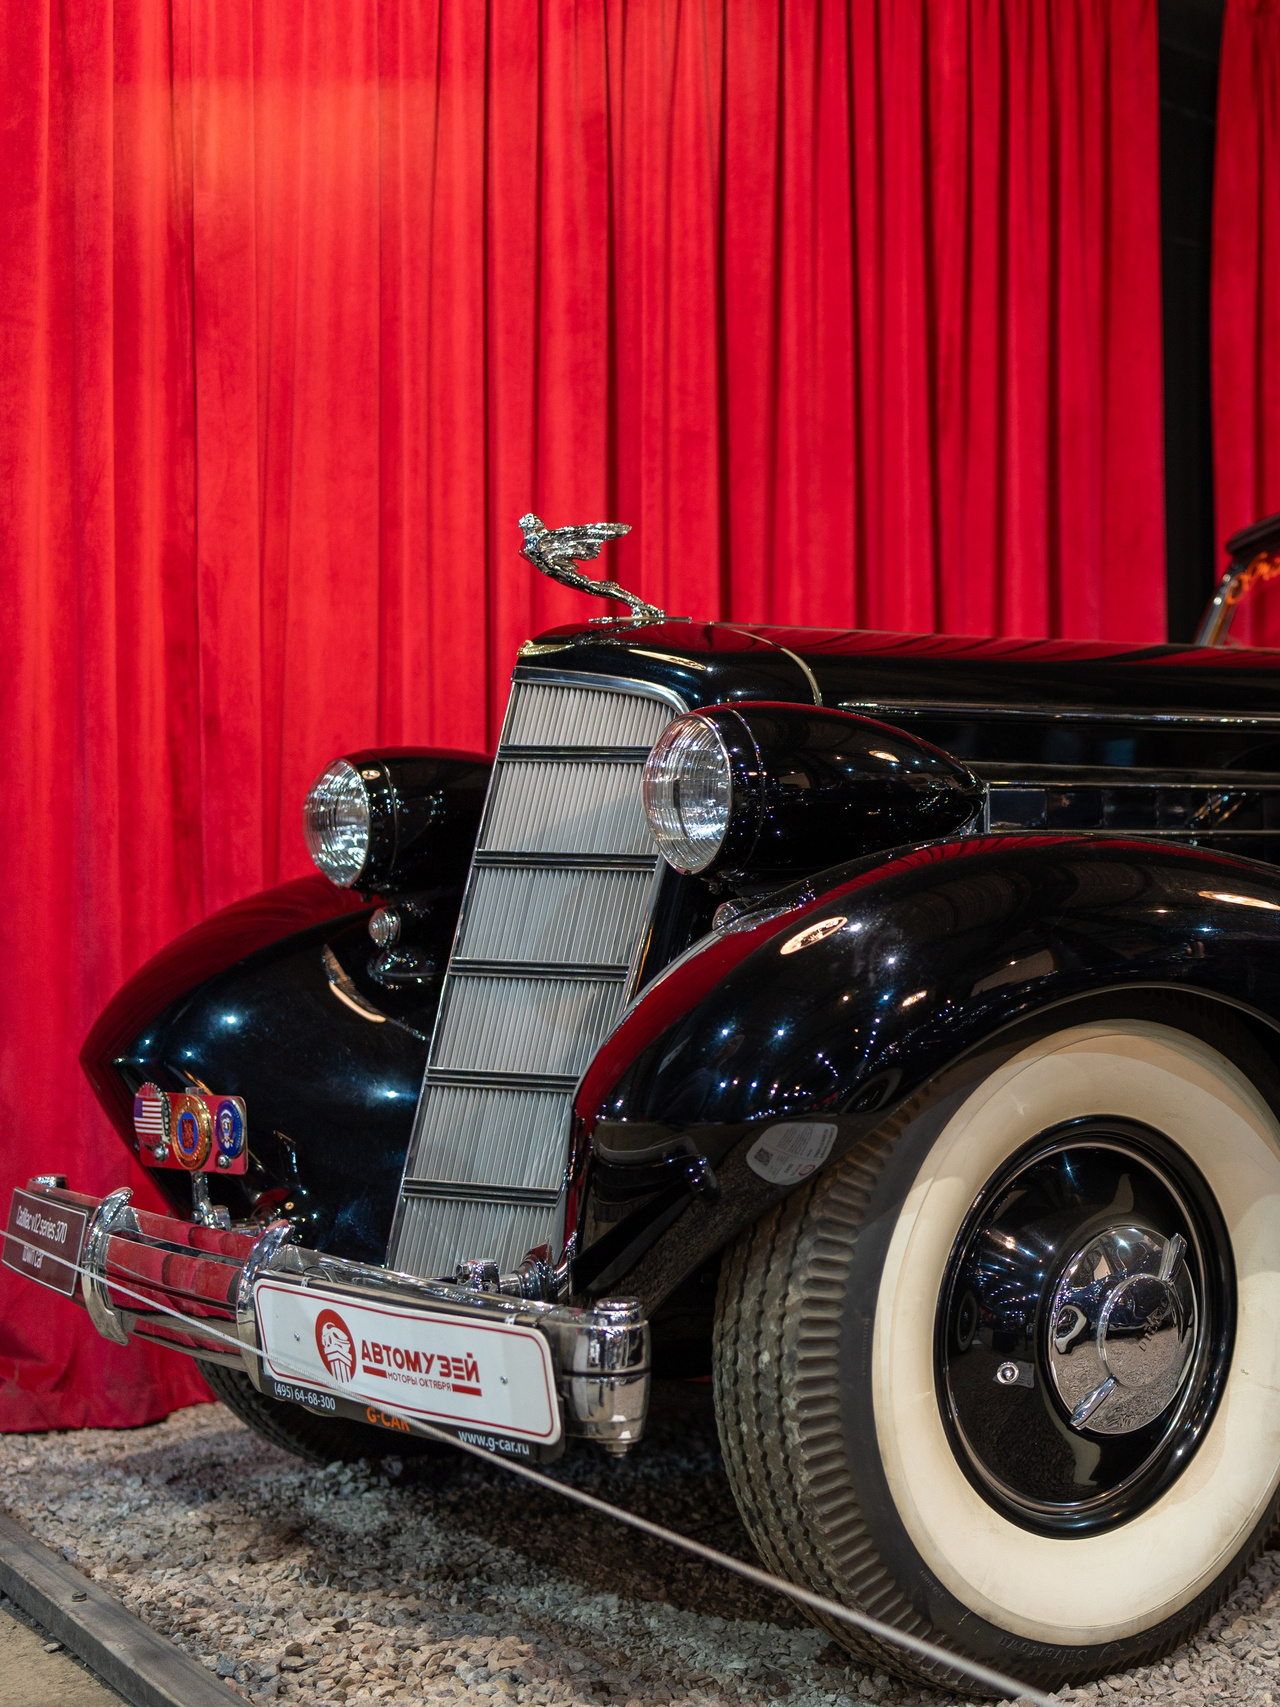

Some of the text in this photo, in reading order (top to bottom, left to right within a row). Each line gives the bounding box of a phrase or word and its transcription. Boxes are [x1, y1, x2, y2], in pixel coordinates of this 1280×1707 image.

[40, 1217, 56, 1240] series
[55, 1221, 68, 1244] 370
[361, 1339, 480, 1383] АВТОМУЗЕЙ
[387, 1372, 452, 1392] МОТОРЫ ОКТЯБРЯ
[274, 1382, 336, 1411] (495) 64-68-300
[458, 1430, 530, 1456] www.g-car.ru
